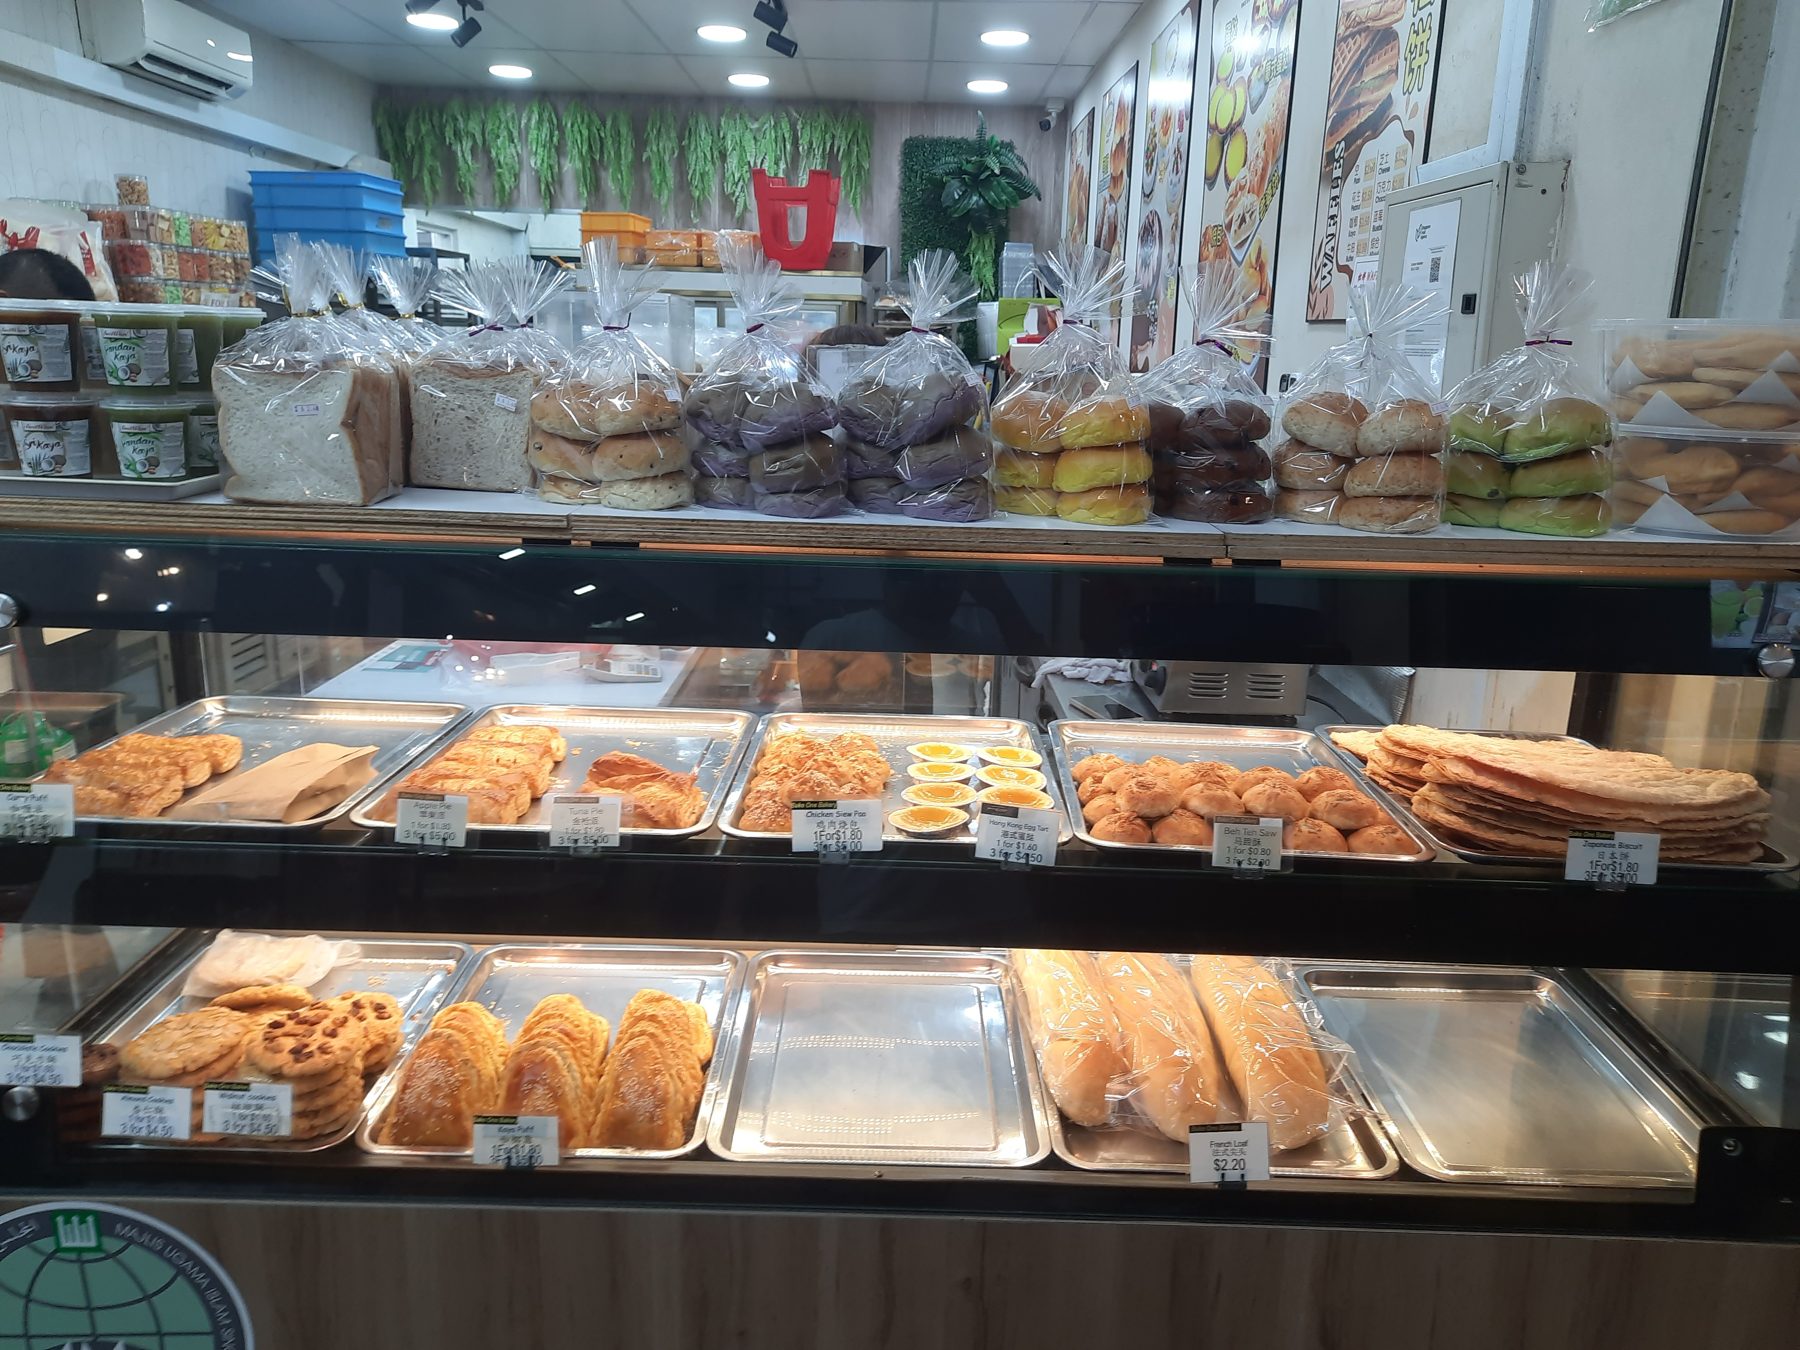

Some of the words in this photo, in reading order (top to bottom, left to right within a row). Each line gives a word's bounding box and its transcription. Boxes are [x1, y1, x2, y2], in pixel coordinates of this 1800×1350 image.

[1402, 0, 1433, 95] 饼
[1319, 140, 1346, 293] WAFFLES
[113, 352, 136, 364] Kaya
[131, 446, 155, 457] Kaya
[413, 801, 438, 810] Apple
[439, 802, 452, 810] Pie
[569, 807, 589, 815] Tuna
[591, 807, 604, 815] Pie
[806, 810, 833, 818] Chicken
[836, 810, 852, 818] Siew
[417, 821, 429, 829] for
[989, 819, 1006, 828] Hong
[1007, 821, 1022, 830] Kong
[1024, 823, 1036, 832] Egg
[1037, 824, 1049, 832] Tart
[404, 829, 411, 839] 3
[412, 829, 427, 840] for
[1224, 826, 1240, 836] Beh
[1259, 828, 1277, 838] Saw
[558, 835, 564, 845] 3
[566, 835, 581, 845] for
[583, 835, 609, 845] $500
[1582, 840, 1616, 849] Japanese
[1617, 841, 1643, 850] Biscuit
[1002, 840, 1015, 849] for
[1016, 841, 1038, 852] $1.60
[1233, 846, 1246, 855] for
[1247, 846, 1272, 856] $0.80
[989, 848, 997, 858] 3
[999, 848, 1014, 859] for
[1014, 850, 1043, 863] $450
[1225, 856, 1231, 864] 3
[1233, 856, 1245, 866] for
[223, 1119, 231, 1132] 3
[1209, 1140, 1232, 1148] French
[1233, 1139, 1249, 1148] Loaf
[1213, 1158, 1246, 1172] $2.20
[114, 1222, 165, 1250] MAJLIS
[163, 1245, 210, 1289] UGAMA
[204, 1287, 233, 1325] ISLAM
